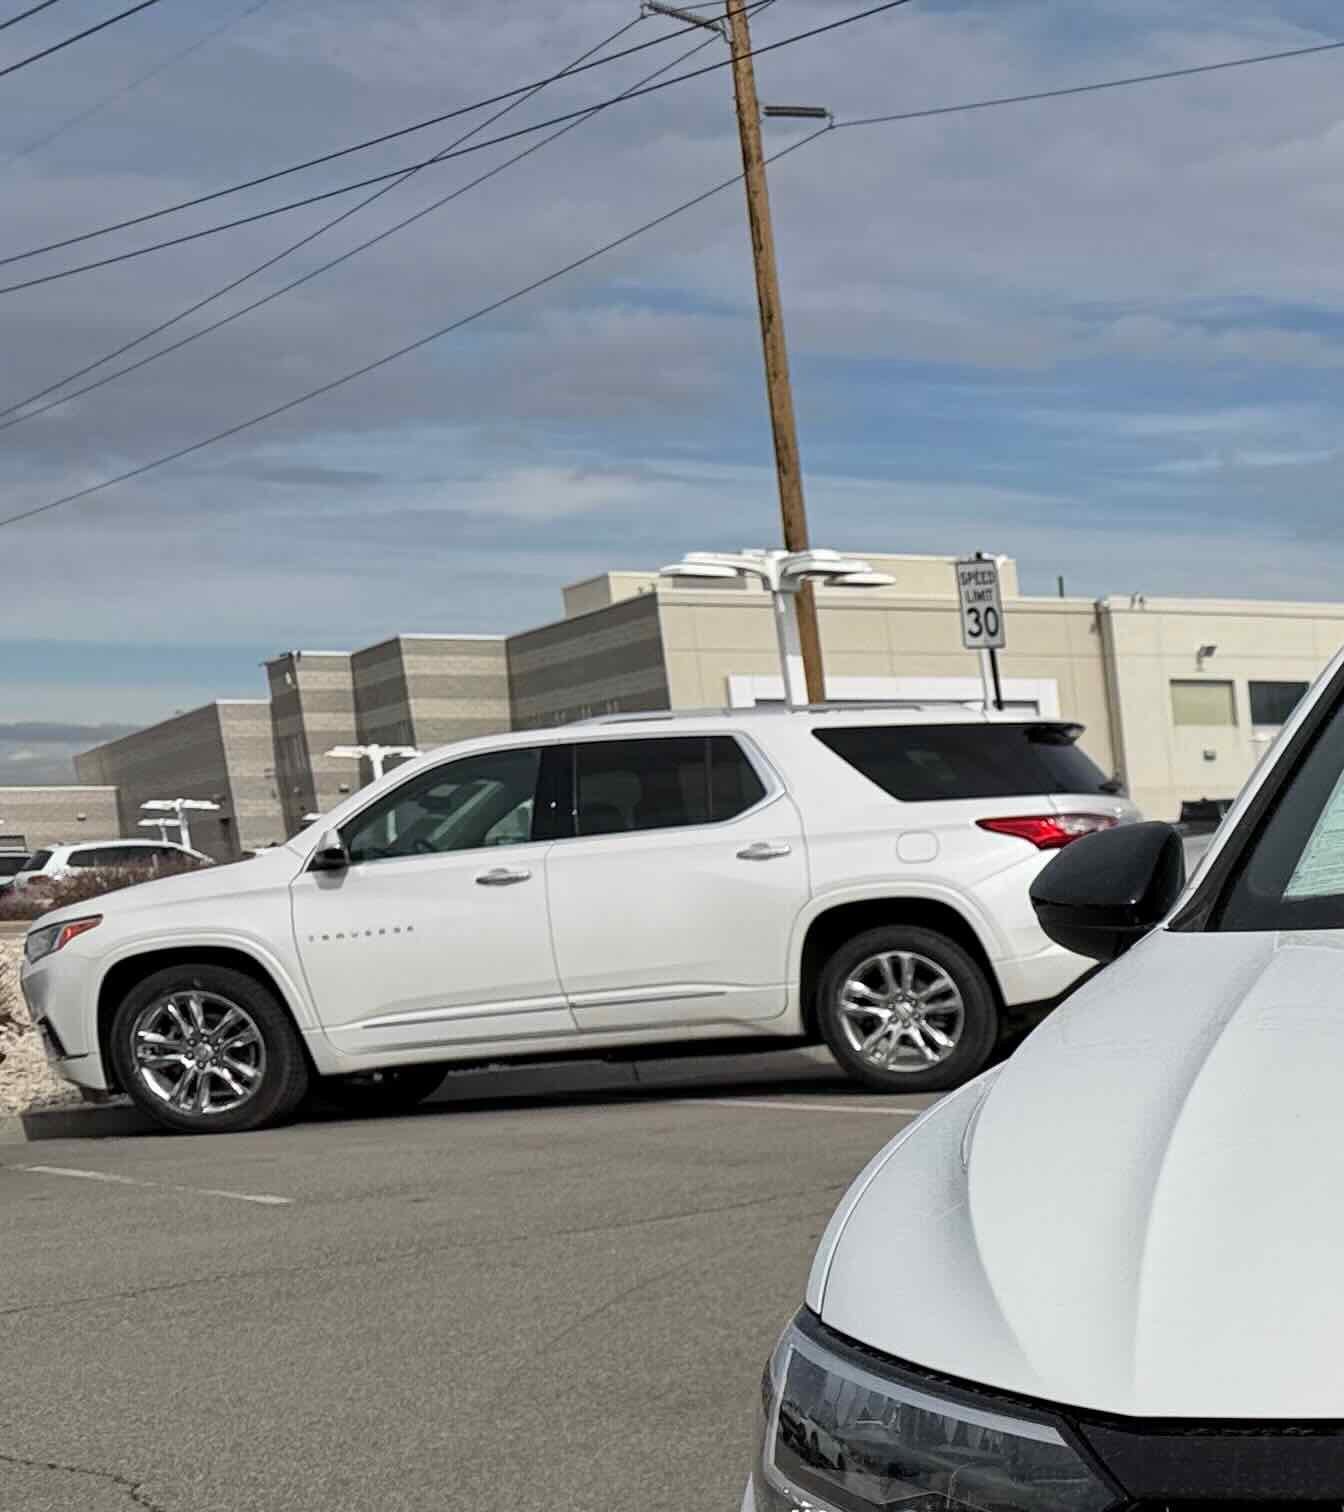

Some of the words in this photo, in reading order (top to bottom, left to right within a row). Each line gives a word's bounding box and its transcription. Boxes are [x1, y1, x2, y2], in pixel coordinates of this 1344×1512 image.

[960, 571, 996, 585] SPEED
[965, 590, 993, 603] LIMIT
[967, 607, 999, 637] 30
